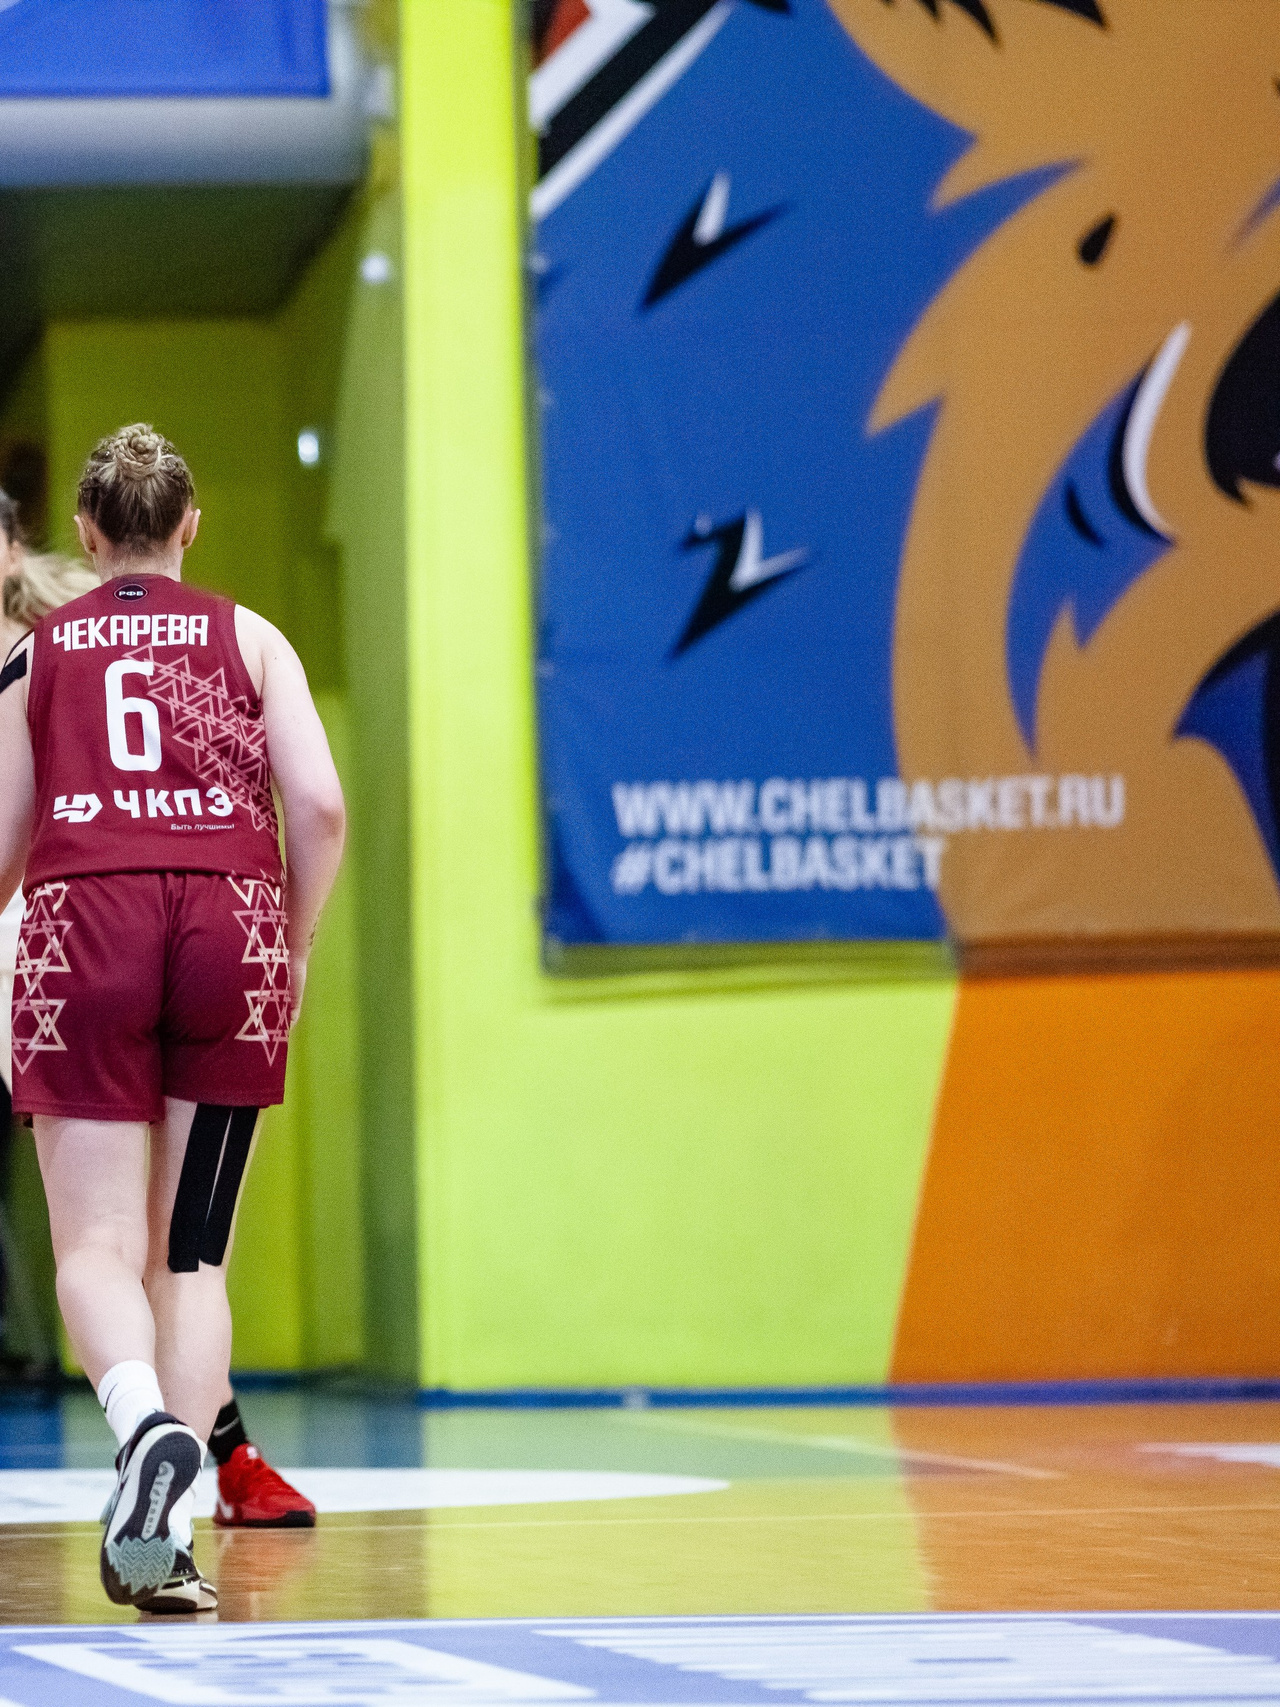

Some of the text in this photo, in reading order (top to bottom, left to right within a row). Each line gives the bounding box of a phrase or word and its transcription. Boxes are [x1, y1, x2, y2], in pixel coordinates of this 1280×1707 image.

[52, 614, 209, 651] ЧЕКАРЕВА
[104, 659, 162, 772] 6
[113, 786, 234, 819] ЧКПЗ
[613, 774, 1124, 835] WWW.CHELBASKET.RU
[170, 823, 192, 831] Быть
[613, 834, 944, 893] #CHELBASKET
